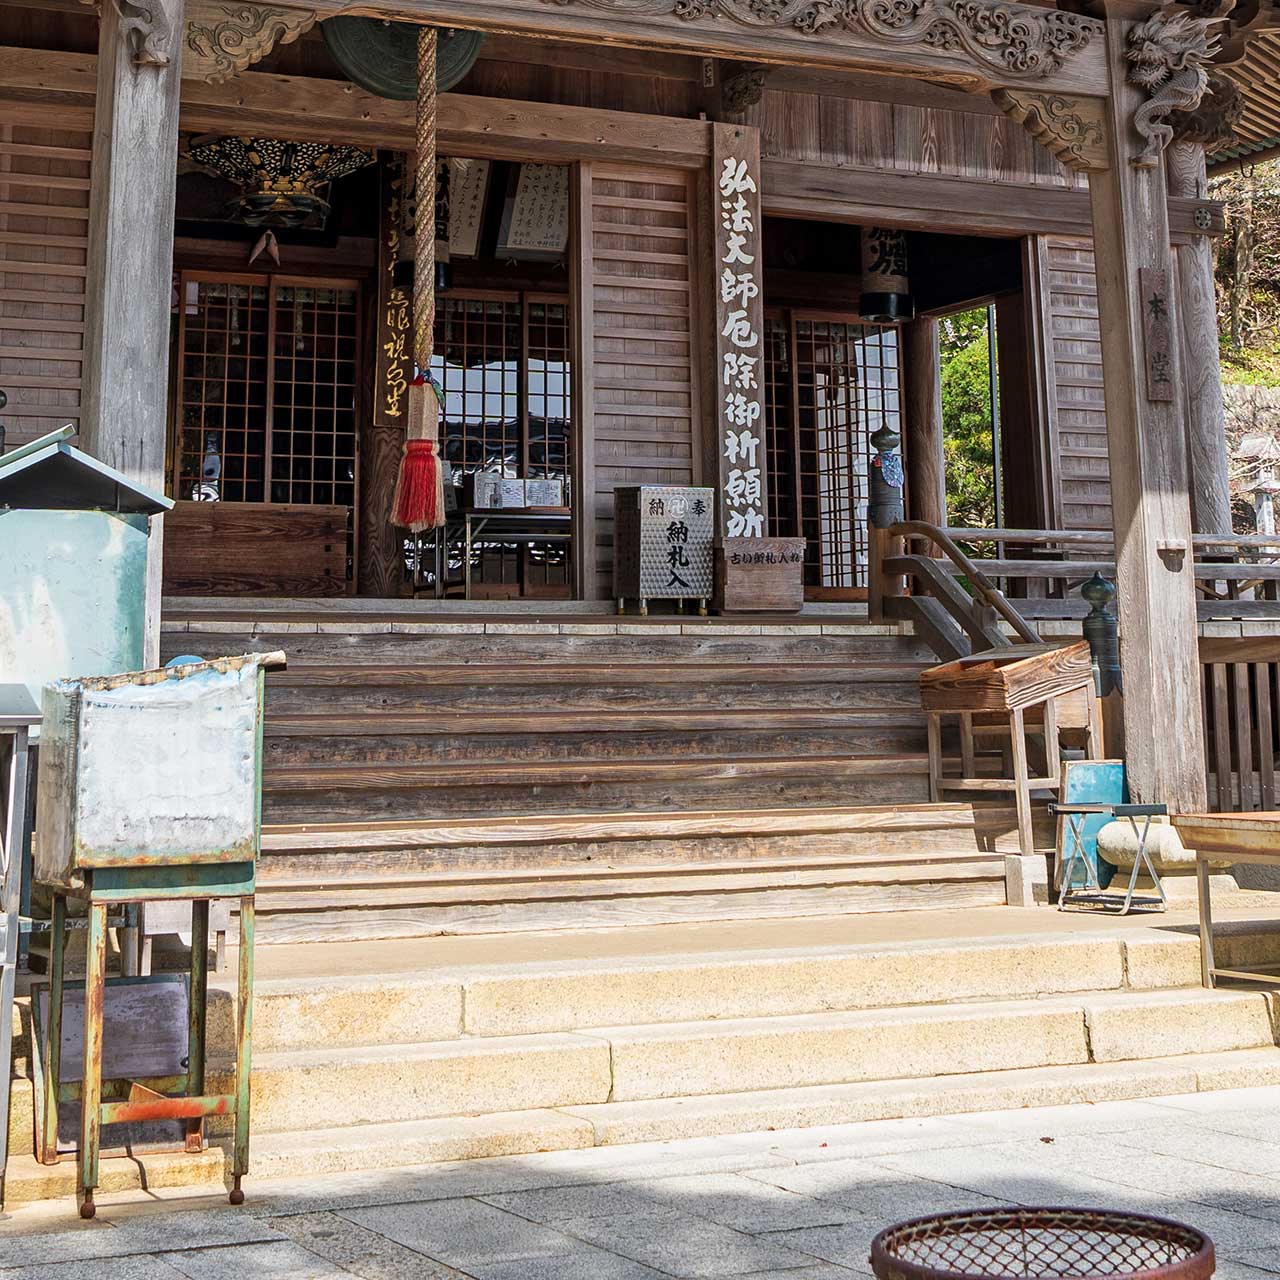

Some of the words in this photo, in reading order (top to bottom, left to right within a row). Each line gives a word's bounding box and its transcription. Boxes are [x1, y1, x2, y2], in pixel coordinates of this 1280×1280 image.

[1148, 292, 1171, 383] 本堂
[666, 520, 690, 588] 納札入
